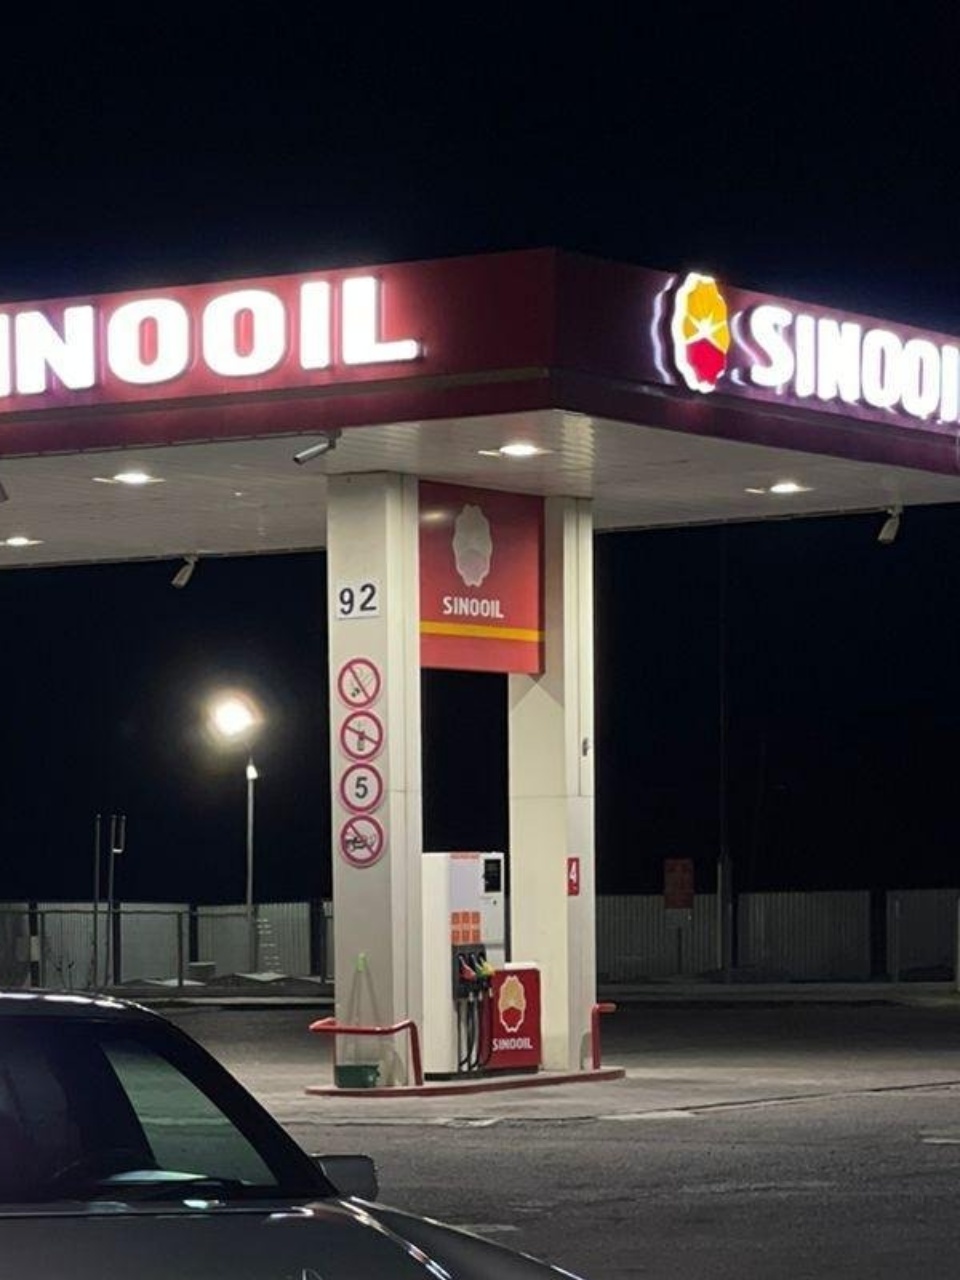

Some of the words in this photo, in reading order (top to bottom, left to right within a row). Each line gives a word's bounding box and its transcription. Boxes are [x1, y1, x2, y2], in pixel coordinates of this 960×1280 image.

[339, 583, 377, 615] 92
[442, 596, 504, 618] SINOOIL
[355, 777, 368, 799] 5
[569, 861, 577, 881] 4
[492, 1037, 533, 1050] SINOOIL
